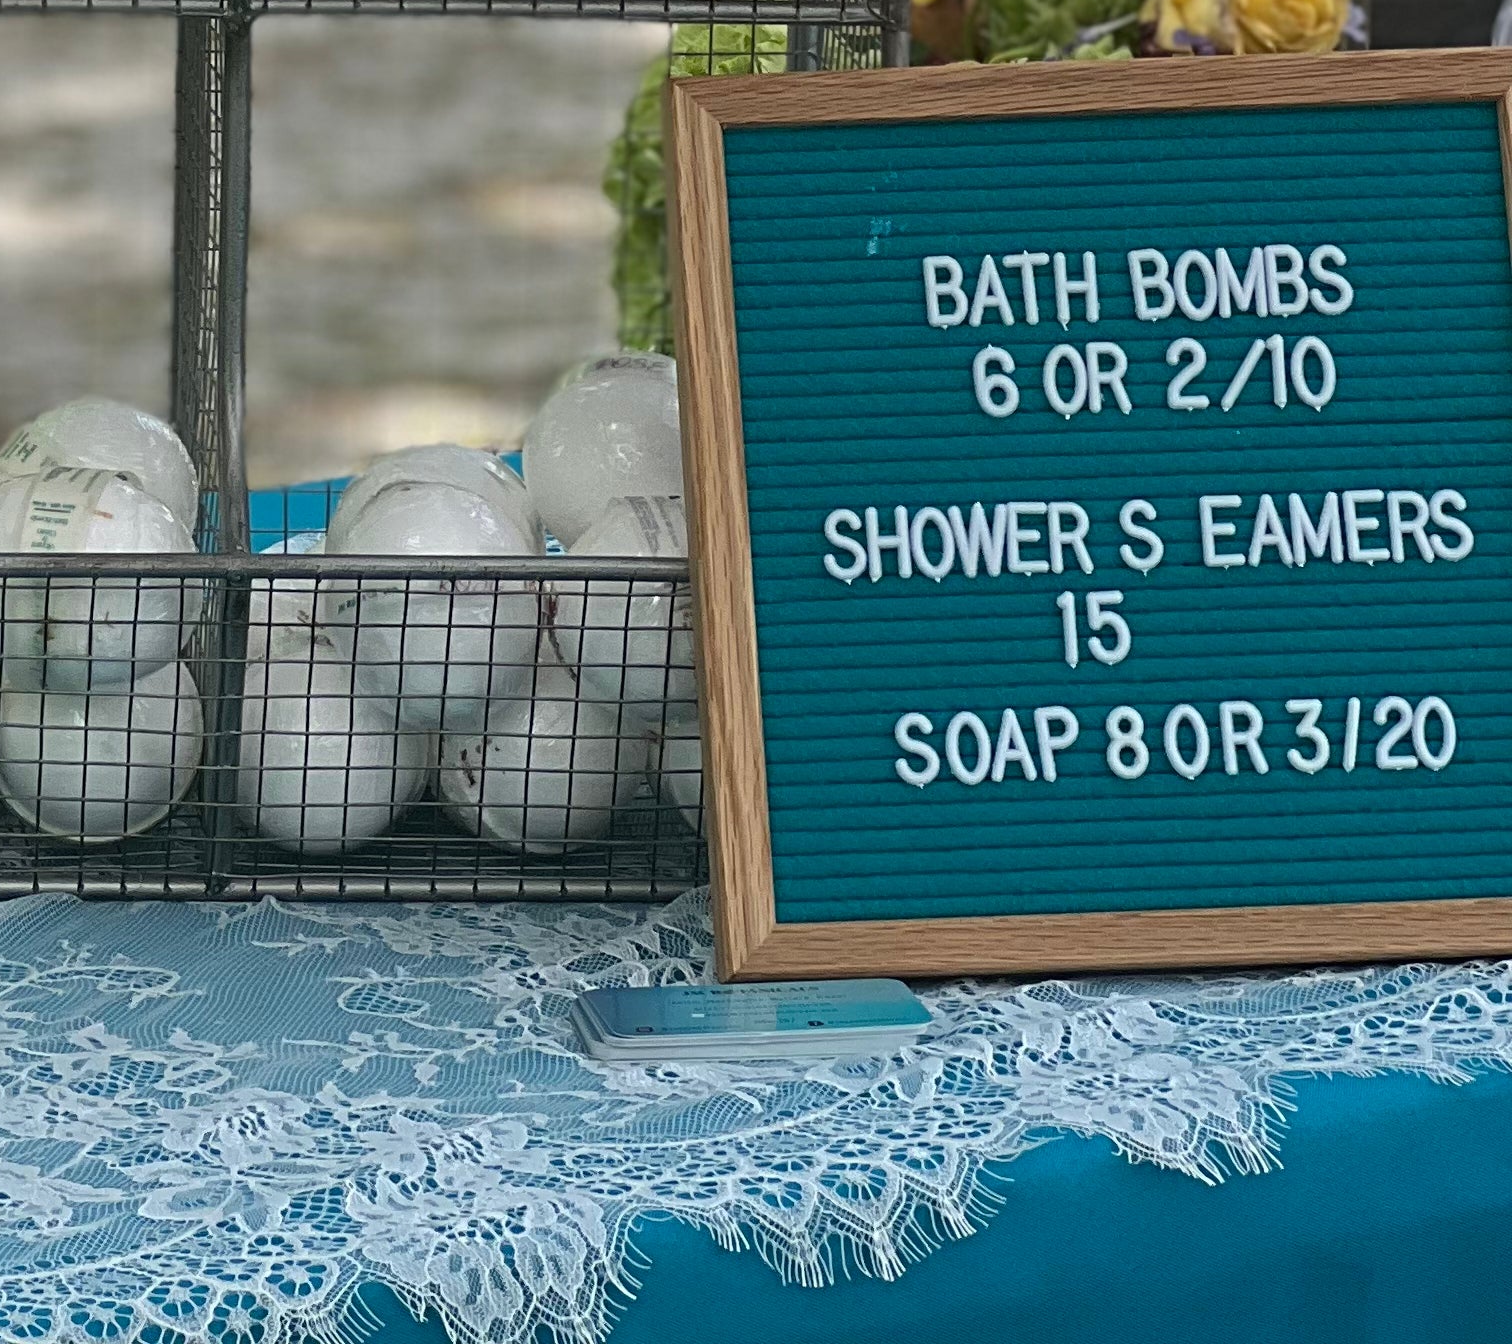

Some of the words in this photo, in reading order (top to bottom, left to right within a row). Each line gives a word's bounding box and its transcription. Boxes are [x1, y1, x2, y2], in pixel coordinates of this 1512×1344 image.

[922, 249, 1100, 330] BATH
[1126, 243, 1355, 323] BOMBS
[972, 343, 1020, 419] 6
[1042, 340, 1134, 419] OR
[823, 499, 1094, 584] SHOWER
[1056, 588, 1132, 669] 15
[893, 704, 1079, 789] SOAP
[1286, 695, 1459, 775] 3/20
